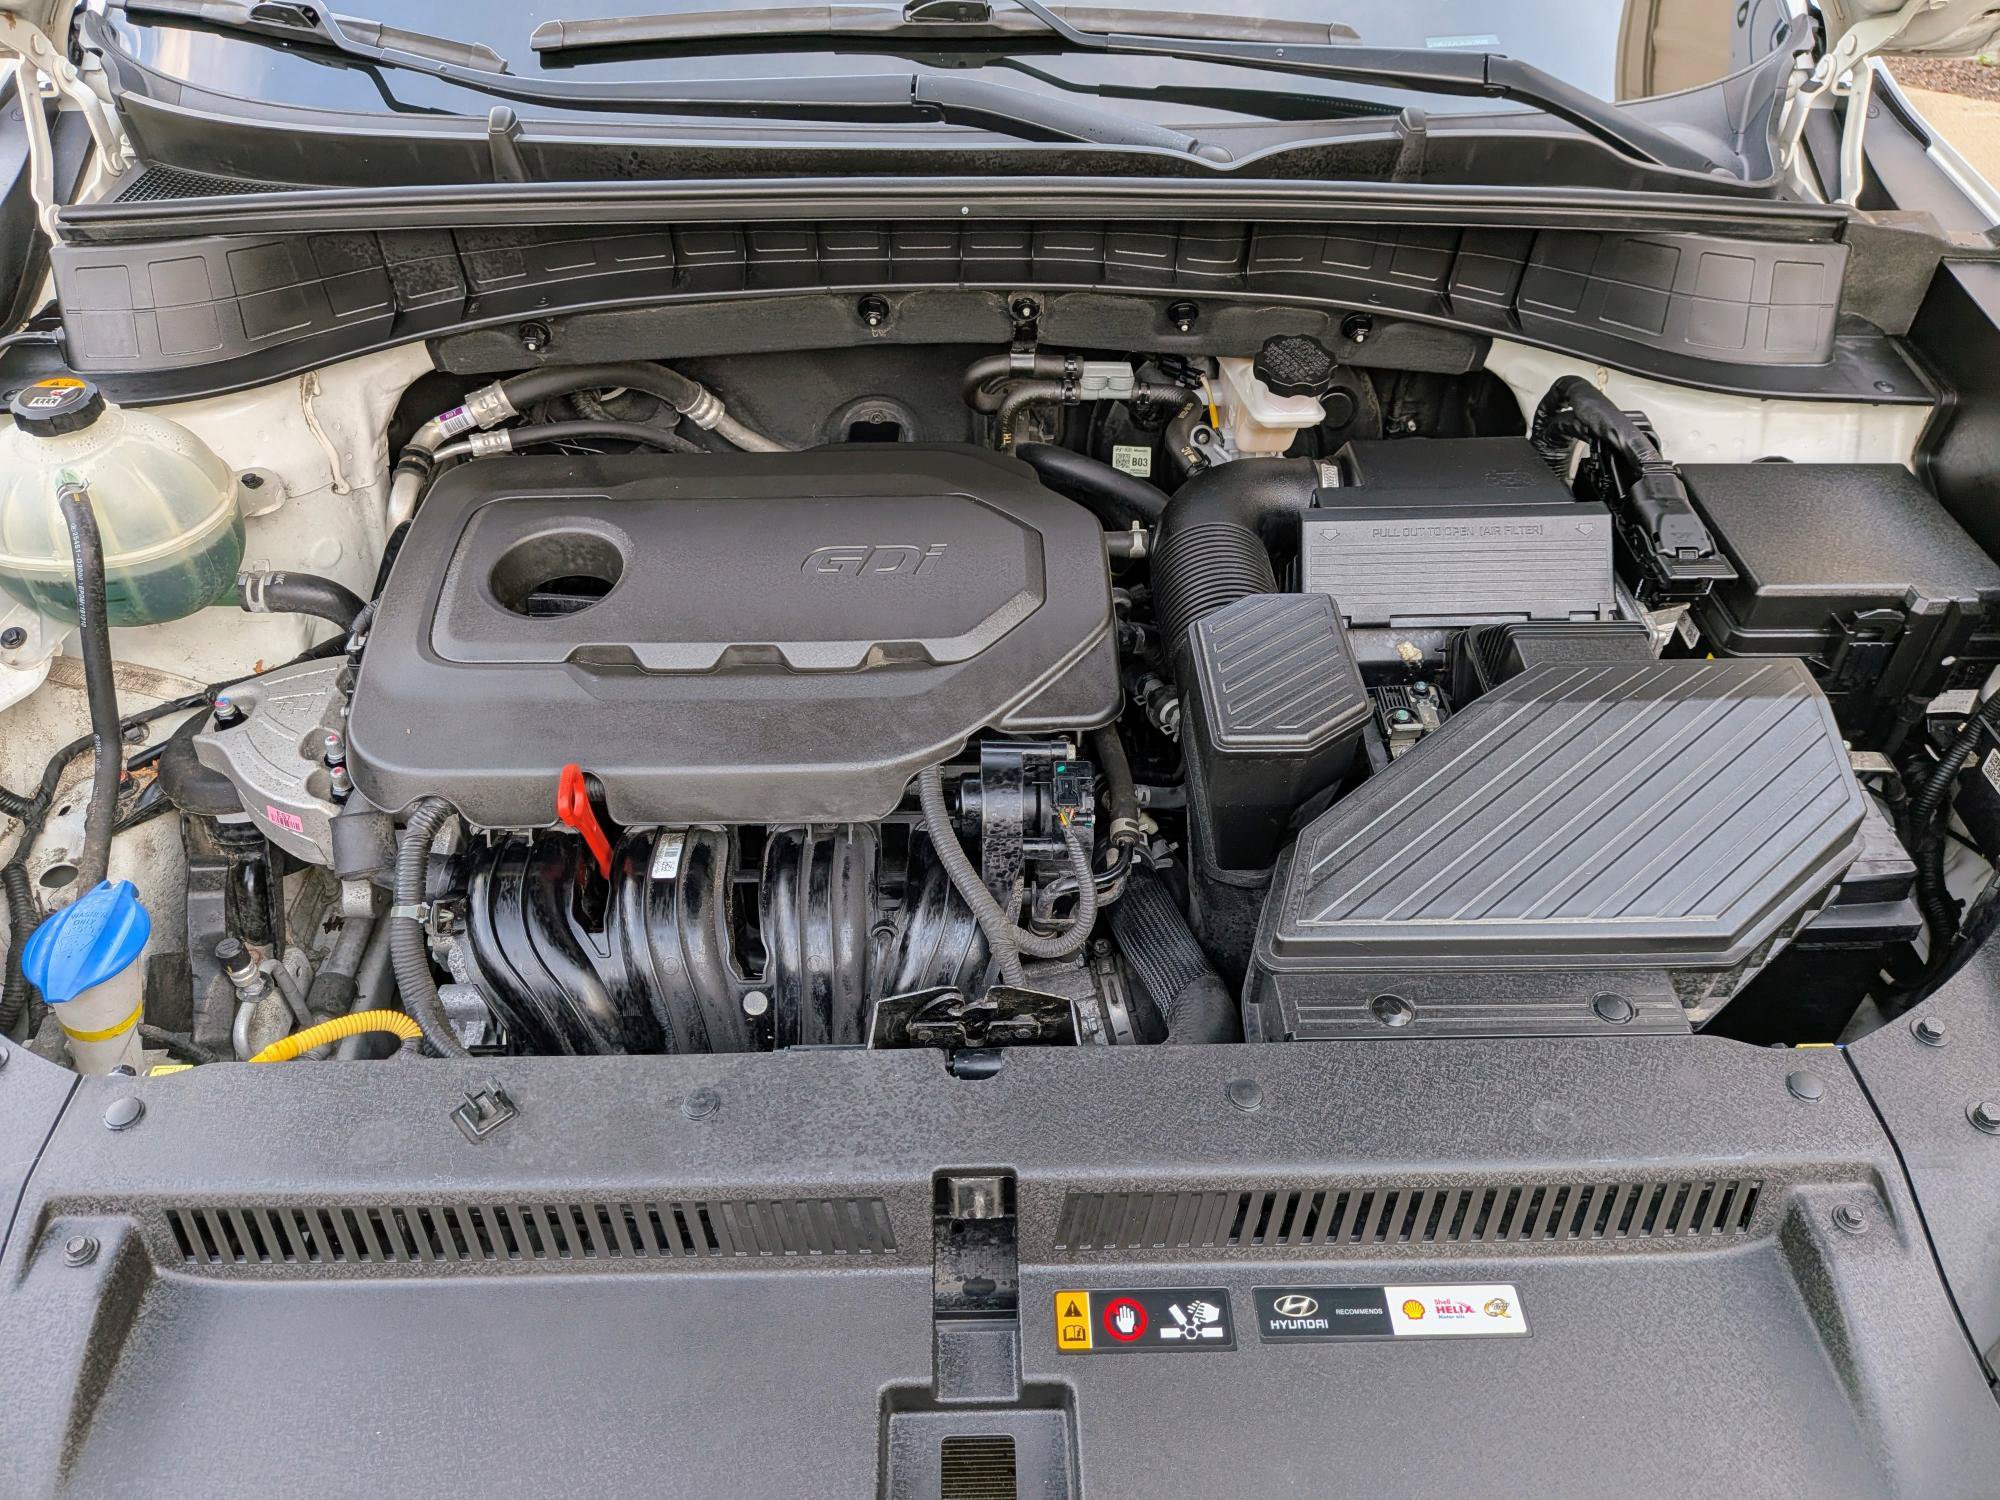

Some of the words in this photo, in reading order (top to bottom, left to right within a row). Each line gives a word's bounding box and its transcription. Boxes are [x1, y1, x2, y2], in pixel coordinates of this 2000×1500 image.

[1131, 457, 1148, 467] B03
[1372, 528, 1400, 538] PULL
[1402, 527, 1425, 537] OUT
[1428, 527, 1441, 537] TO
[1444, 526, 1474, 537] OPEN
[801, 543, 948, 577] GDi
[71, 911, 107, 920] WASHER
[1335, 1308, 1383, 1316] RECOMMENDS
[1436, 1304, 1476, 1314] HELIX
[1270, 1319, 1329, 1330] HYUNDAI
